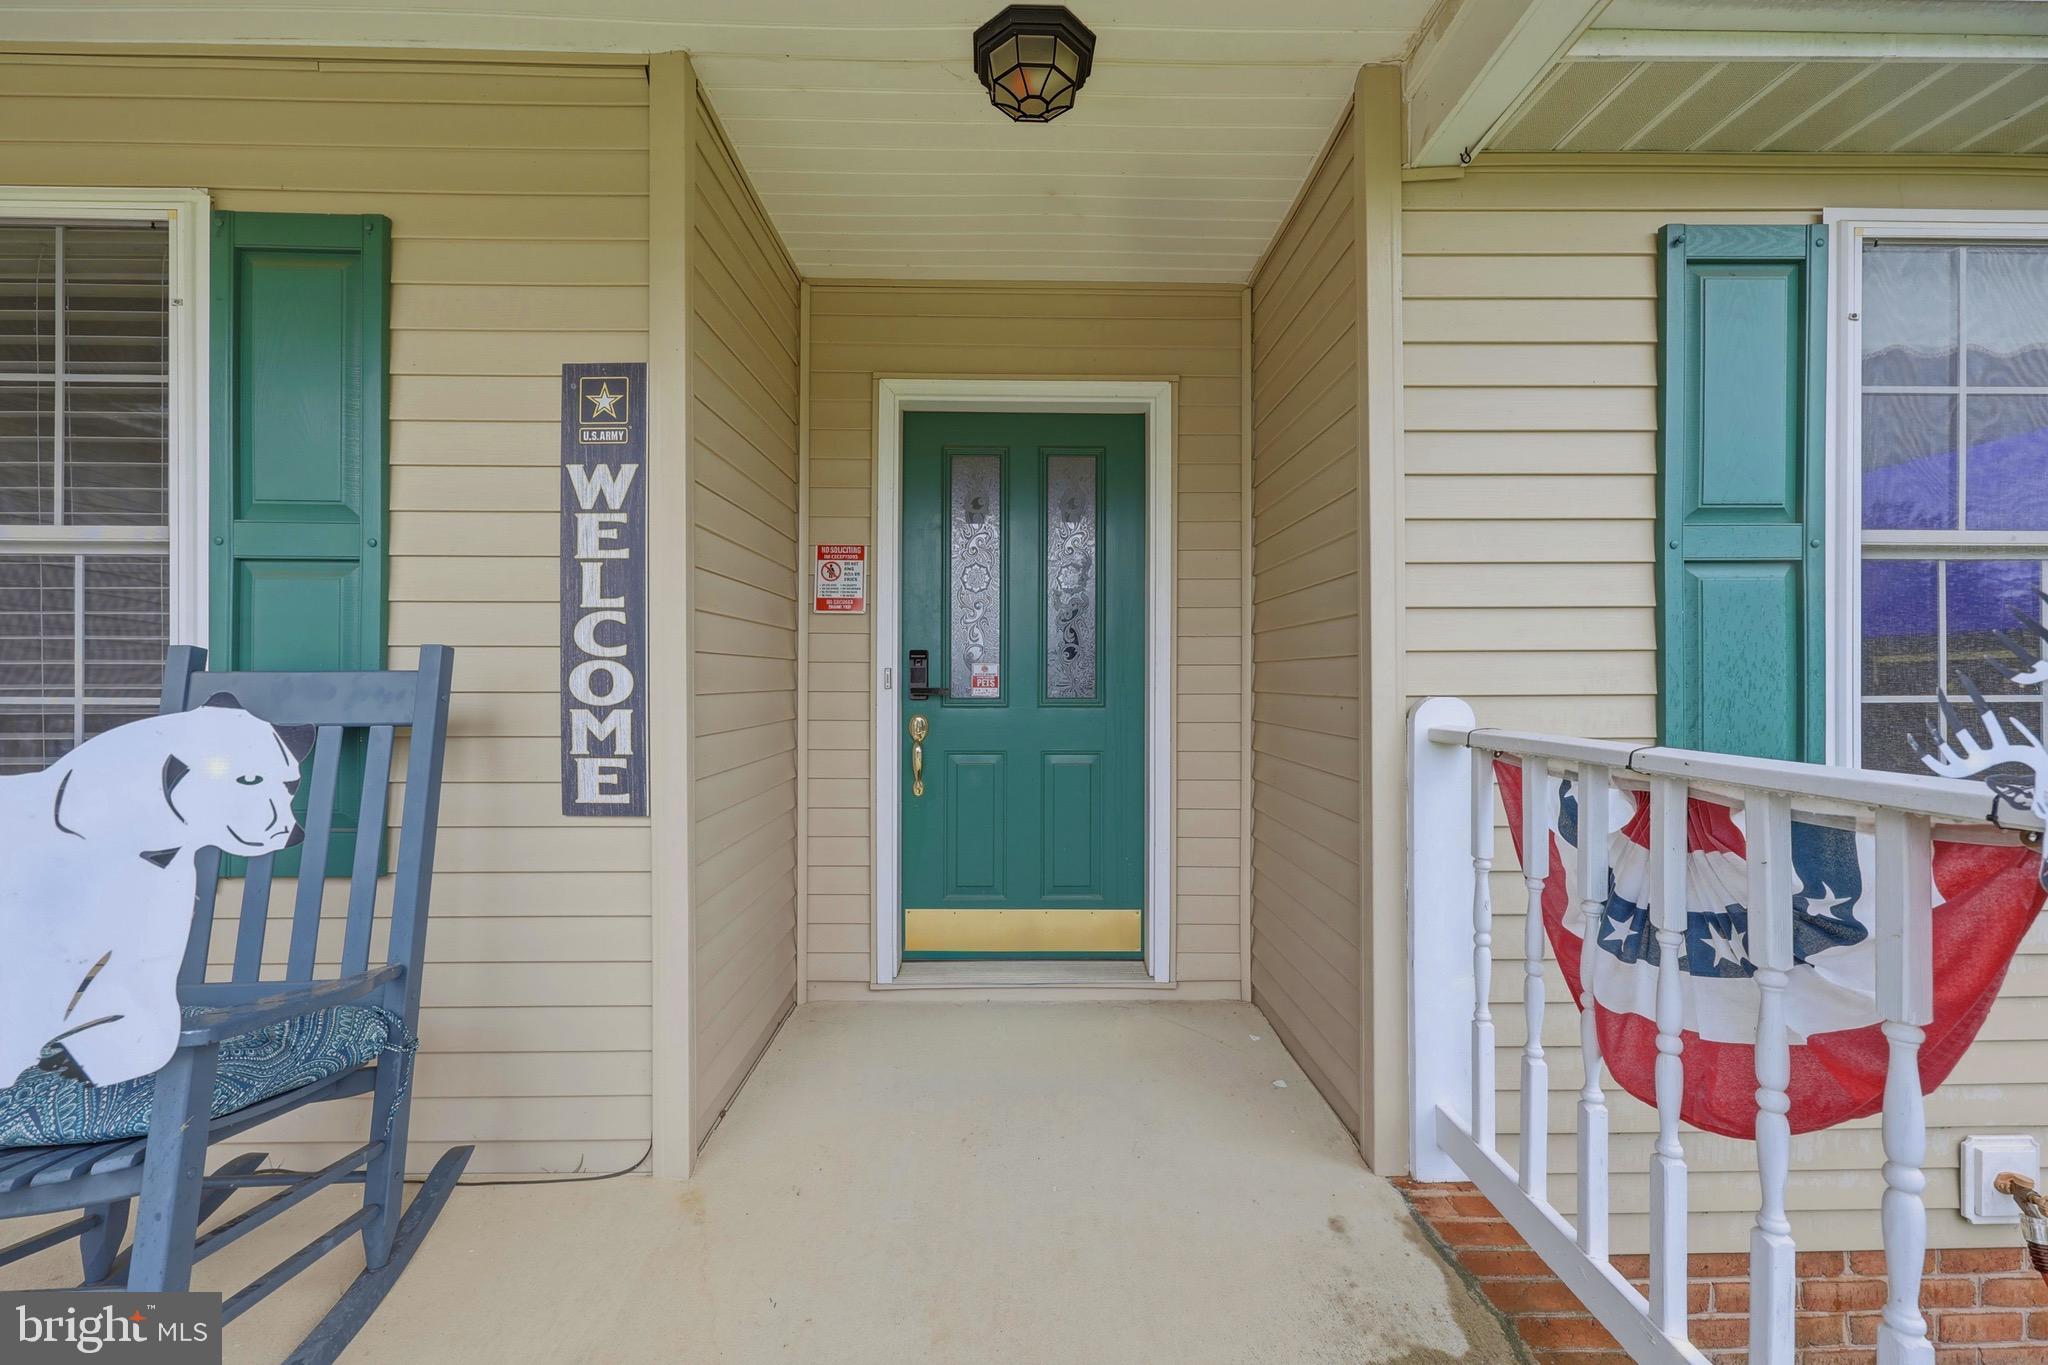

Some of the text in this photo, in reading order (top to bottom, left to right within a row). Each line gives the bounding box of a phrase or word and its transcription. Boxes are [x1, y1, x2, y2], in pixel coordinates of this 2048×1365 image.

[830, 546, 862, 554] SOLICITING
[565, 463, 639, 804] WELCOME
[976, 679, 995, 687] PETS
